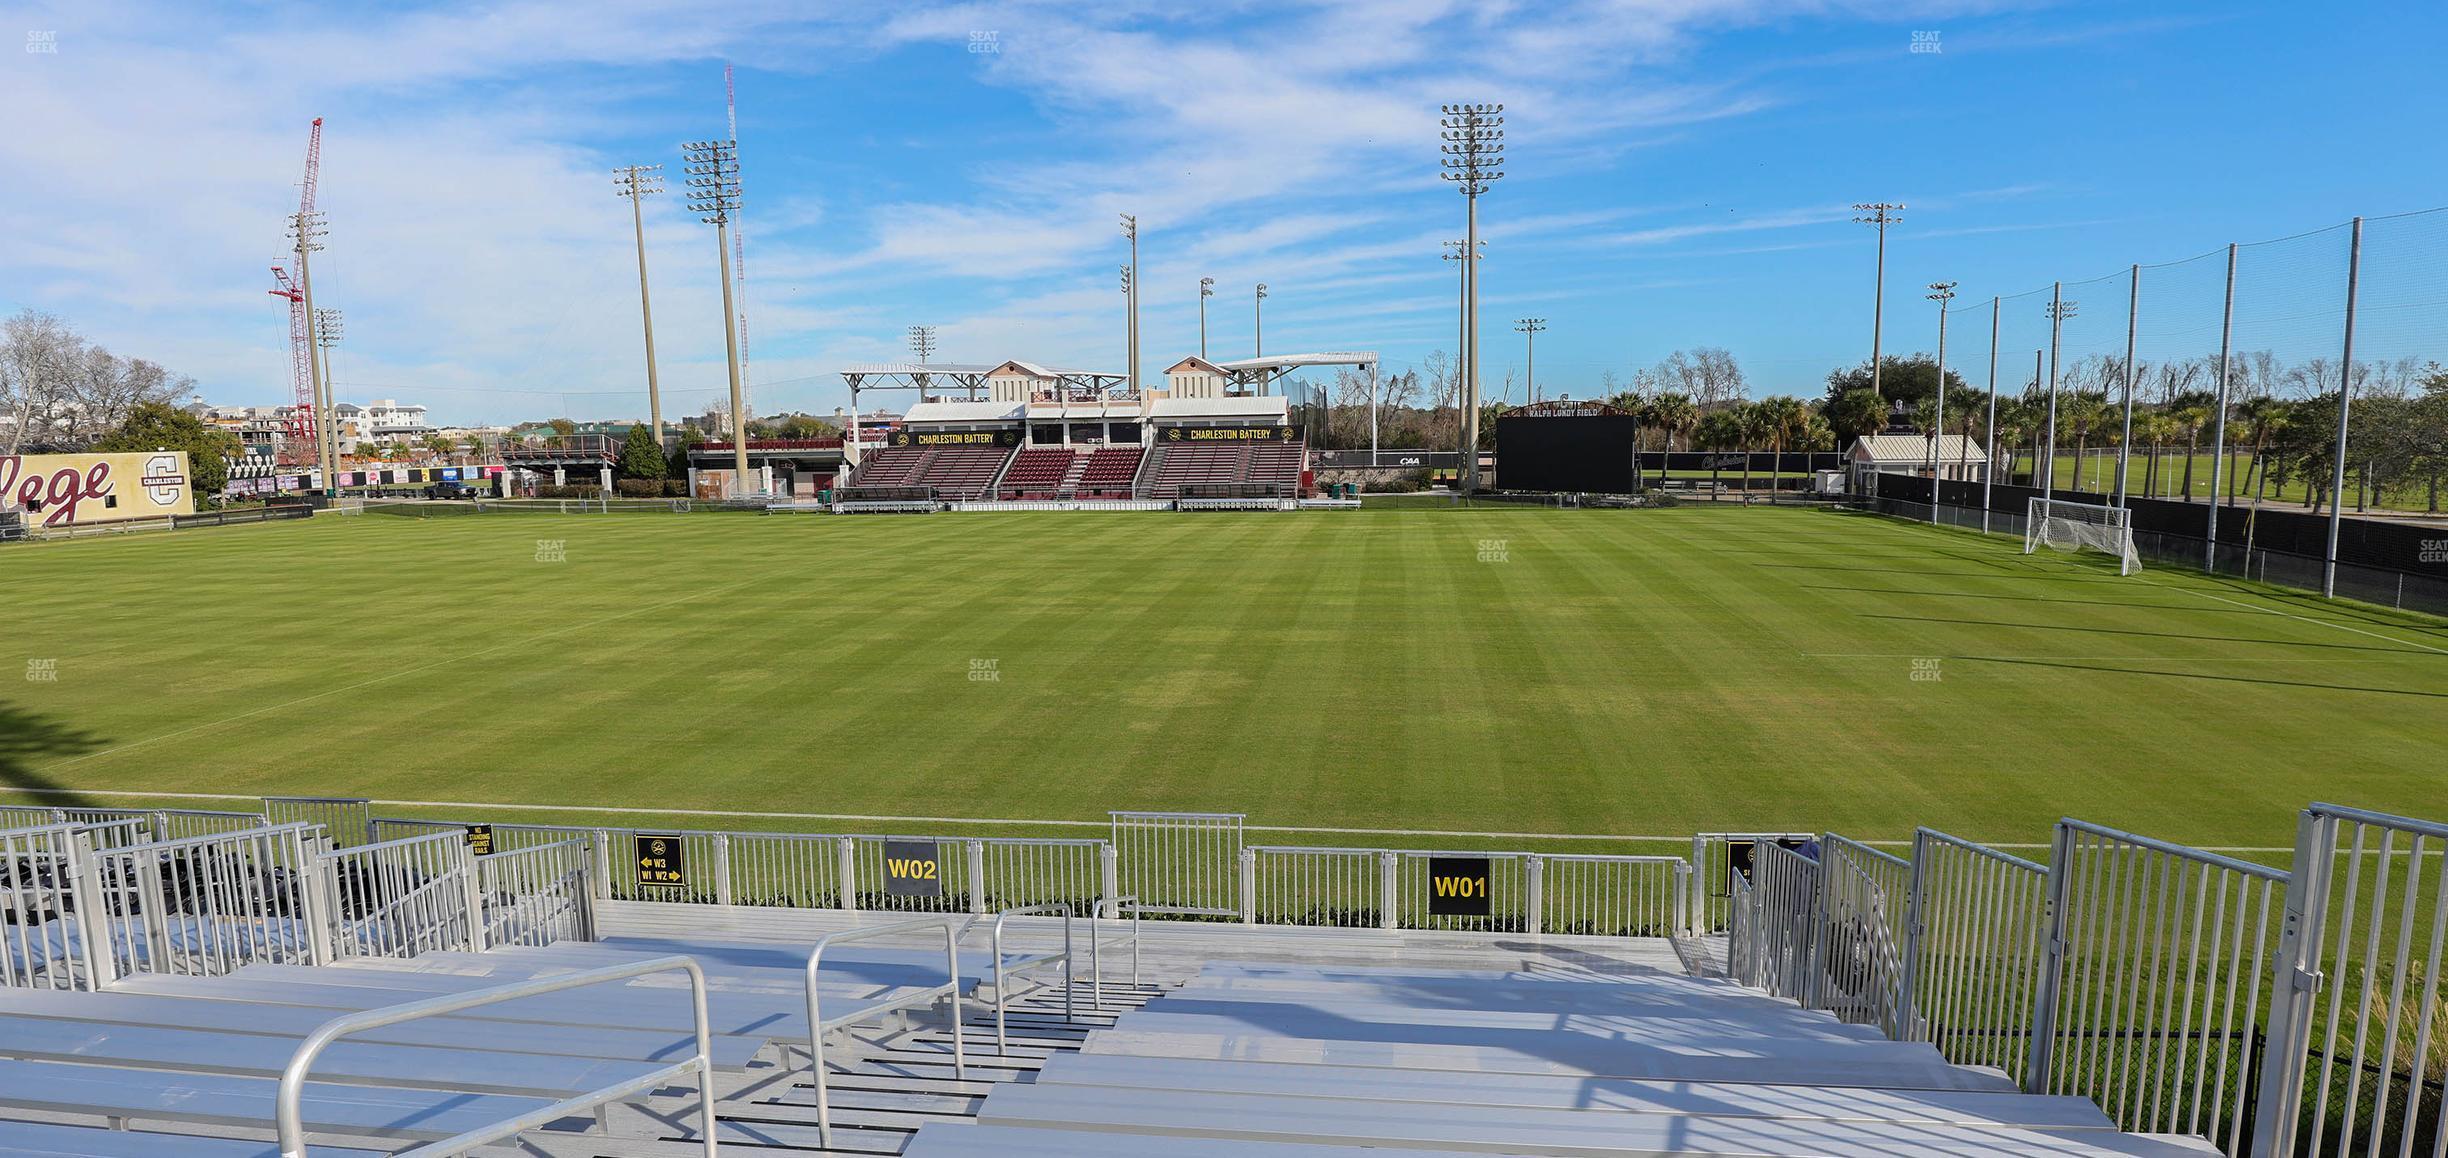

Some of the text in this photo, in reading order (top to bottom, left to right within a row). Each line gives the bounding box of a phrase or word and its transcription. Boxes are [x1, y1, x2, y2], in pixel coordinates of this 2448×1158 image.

[1529, 409, 1598, 418] RALPH LUNDY FIELD
[918, 433, 994, 444] CHARLESTON BATTERY
[1190, 429, 1271, 440] CHARLESTON BATTERY
[1399, 457, 1420, 466] CAA
[468, 833, 490, 841] STANDING
[654, 858, 666, 869] W3
[887, 858, 937, 880] W02
[641, 870, 668, 881] W1 W2
[1434, 876, 1486, 898] W01
